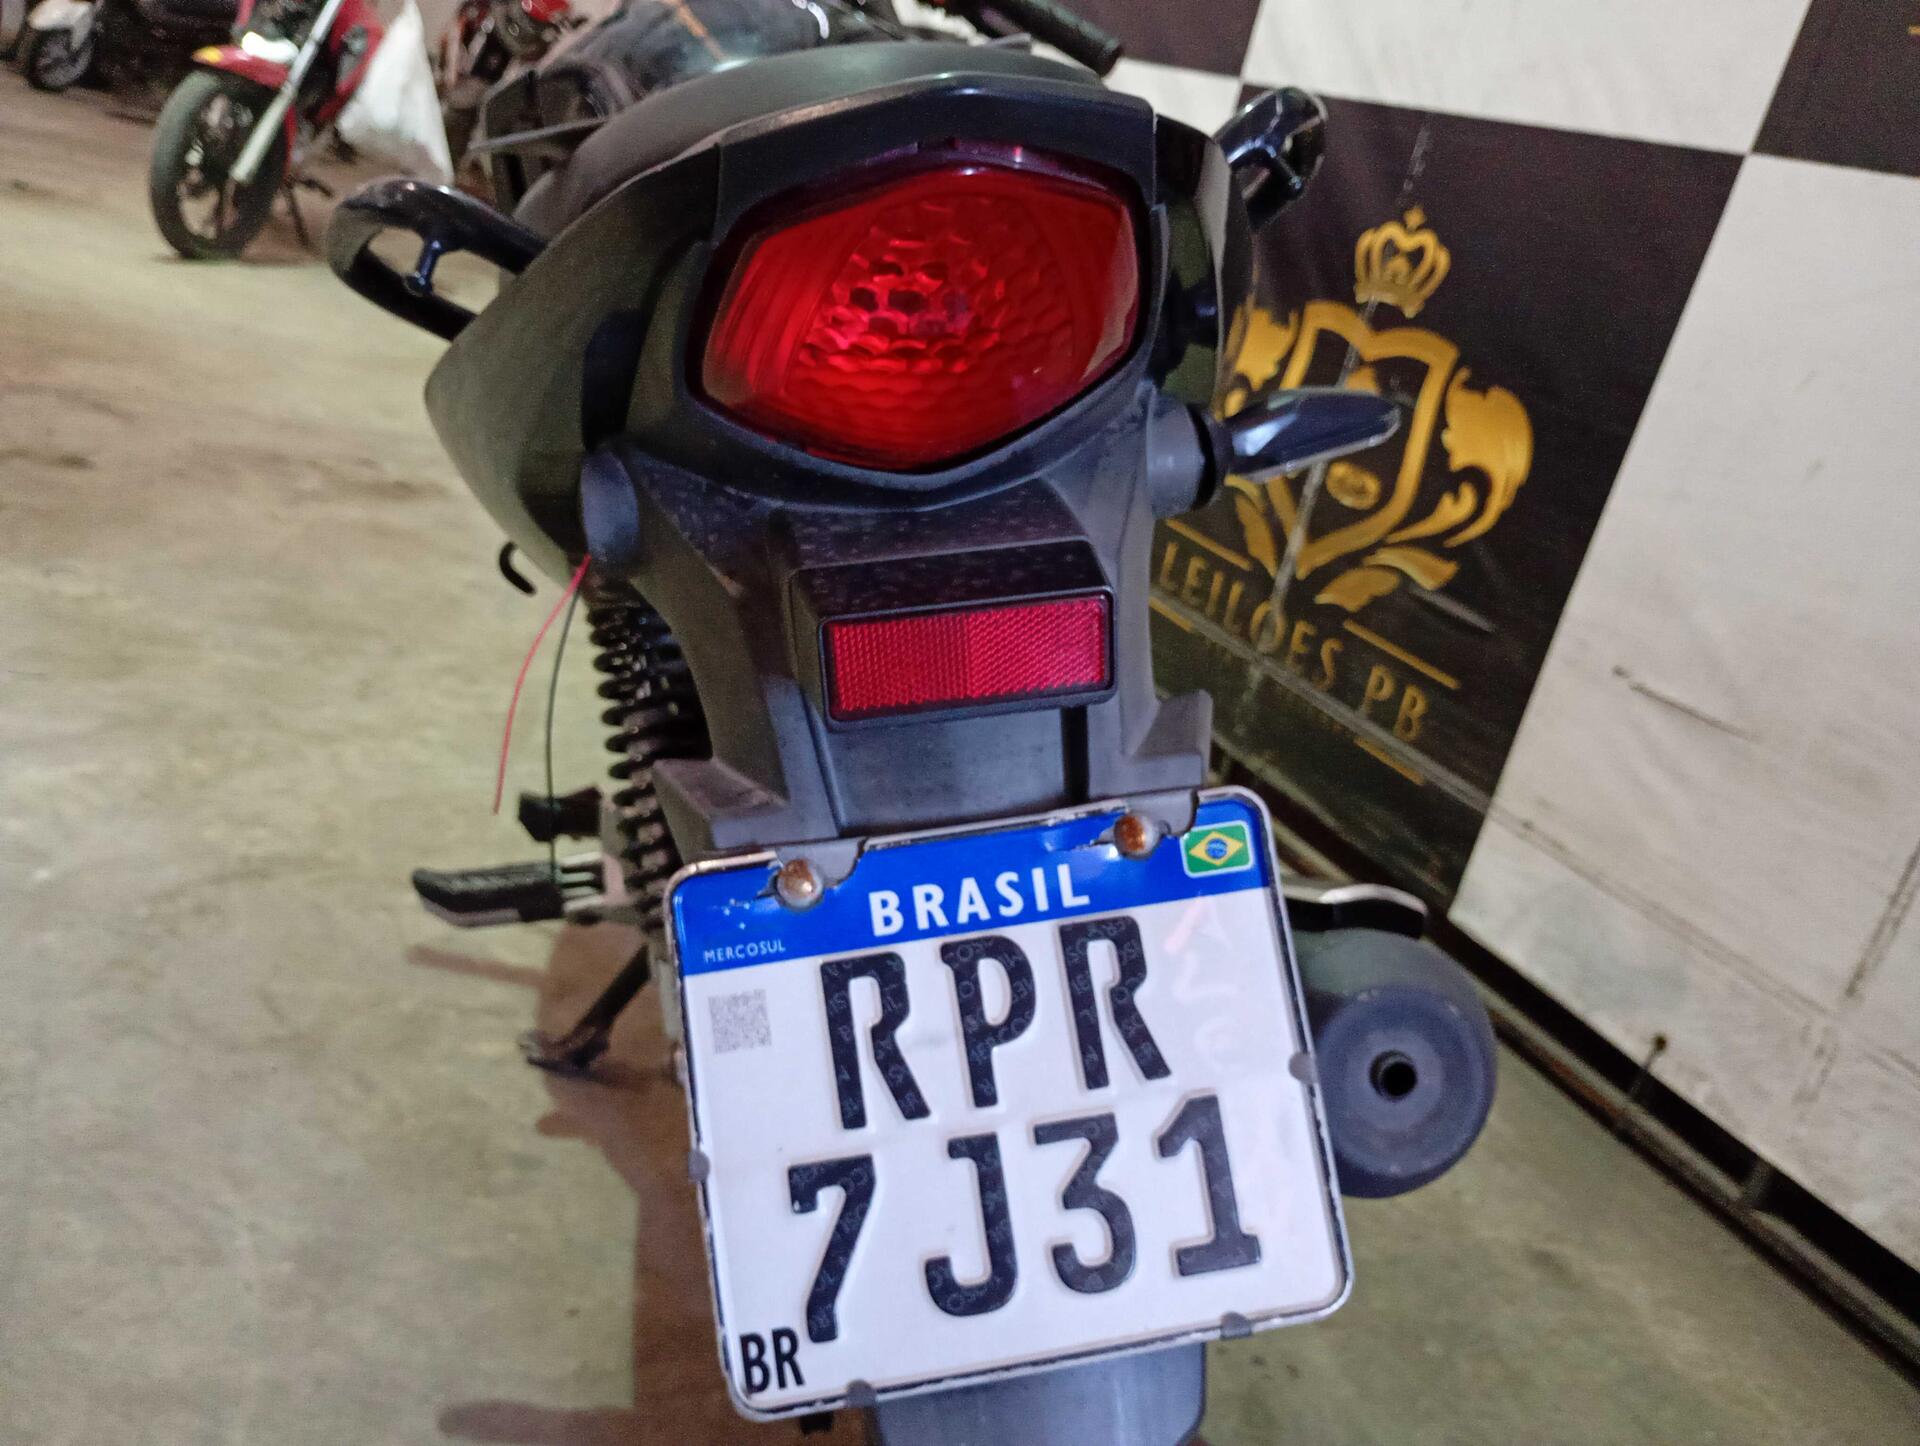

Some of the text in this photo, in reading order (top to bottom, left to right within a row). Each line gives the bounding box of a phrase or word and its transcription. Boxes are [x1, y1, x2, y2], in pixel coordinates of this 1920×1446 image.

[1362, 663, 1430, 742] PB
[868, 863, 1091, 938] BRASIL
[704, 939, 786, 964] MERCOSUL
[818, 914, 1172, 1130] RPR
[786, 1094, 1263, 1344] 7J31
[740, 1326, 805, 1394] BR
